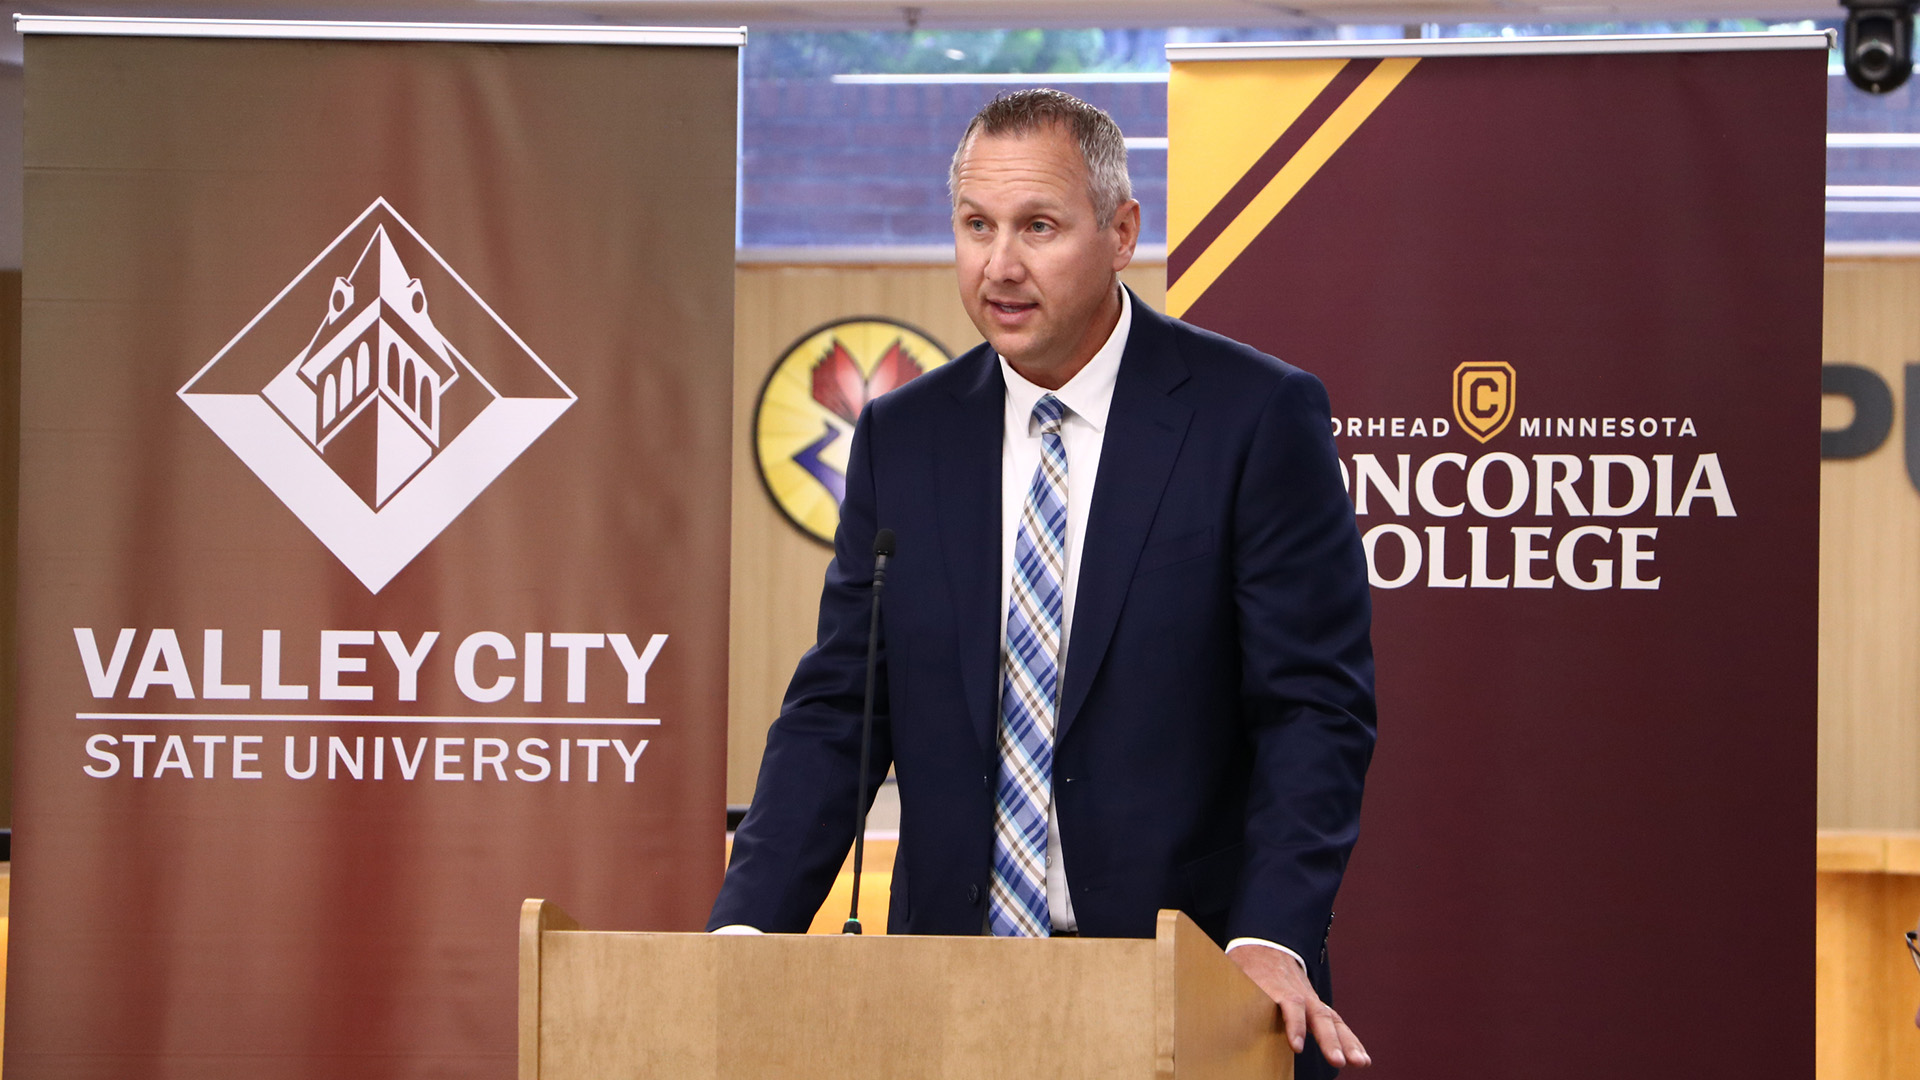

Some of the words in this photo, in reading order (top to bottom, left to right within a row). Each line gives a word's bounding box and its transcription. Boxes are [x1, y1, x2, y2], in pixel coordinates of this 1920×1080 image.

[1470, 377, 1499, 418] C
[1330, 417, 1450, 437] ORHEAD
[1519, 417, 1697, 437] MINNESOTA
[1338, 452, 1738, 518] NCORDIA
[1361, 523, 1661, 590] OLLEGE
[73, 628, 440, 701] VALLEY
[453, 631, 669, 704] CITY
[82, 733, 264, 779] STATE
[284, 735, 649, 783] UNIVERSITY
